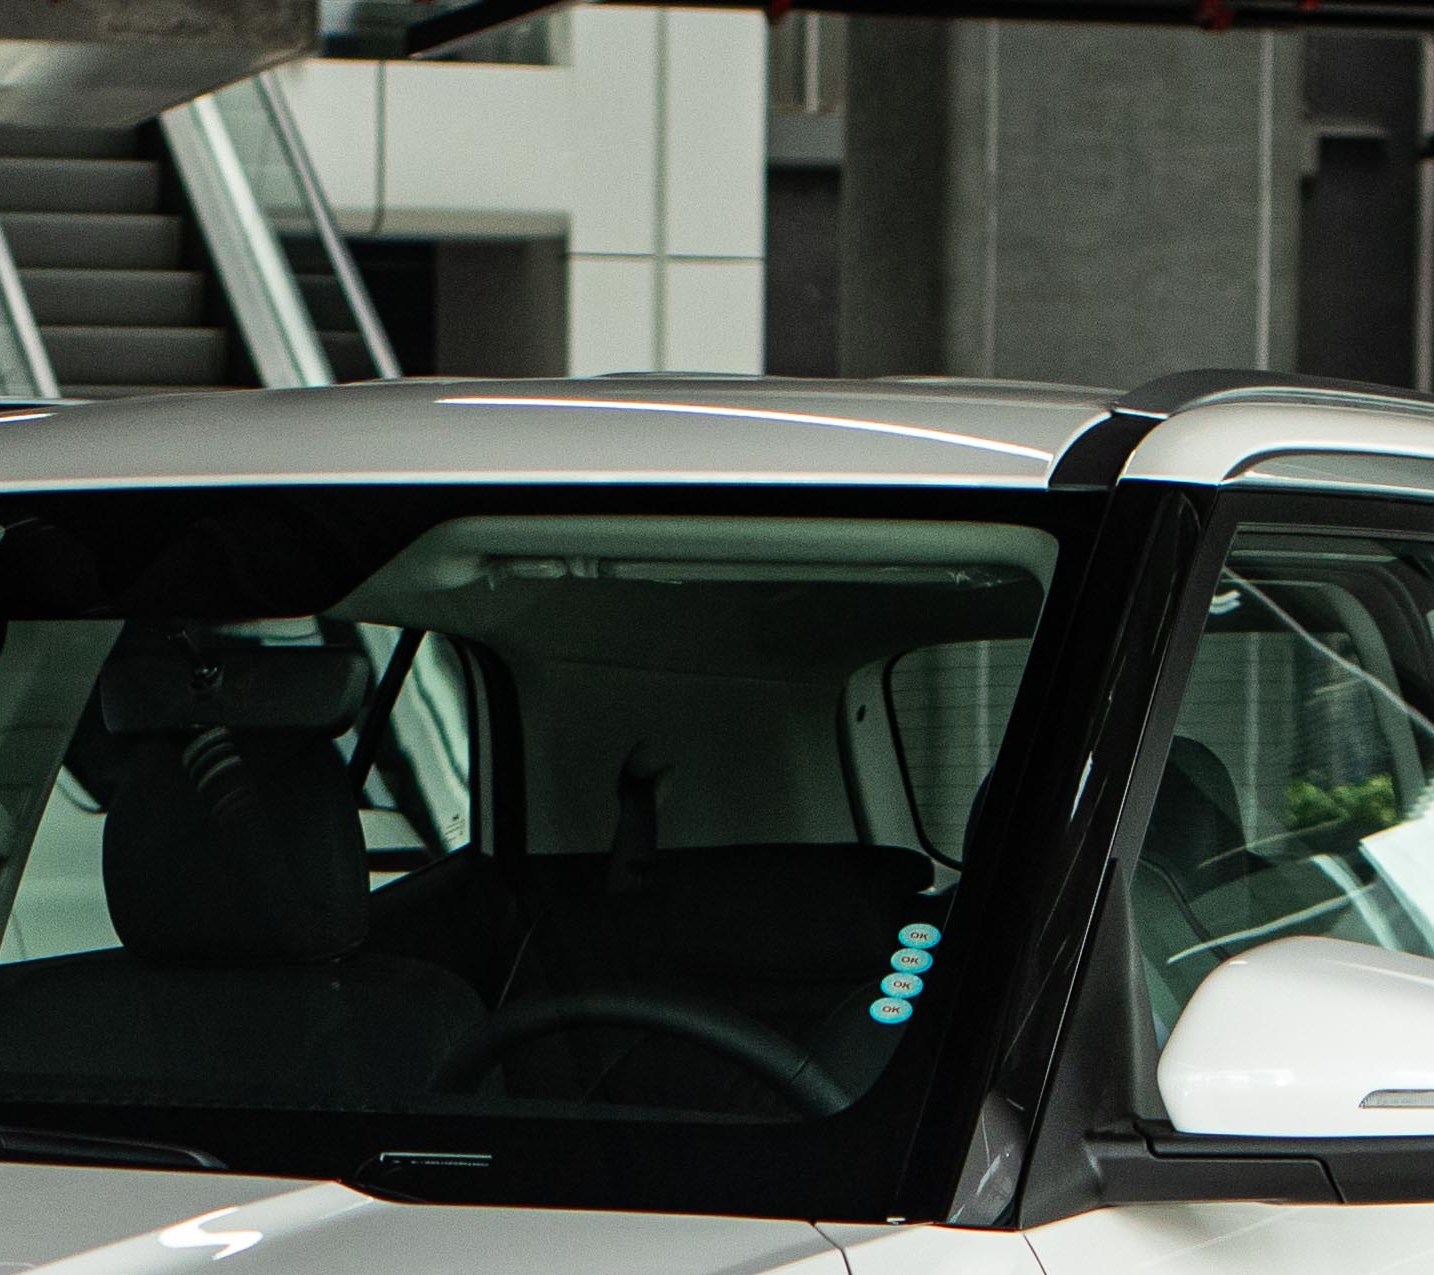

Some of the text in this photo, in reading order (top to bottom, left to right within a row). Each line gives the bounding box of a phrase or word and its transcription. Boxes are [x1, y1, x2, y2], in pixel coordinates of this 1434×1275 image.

[910, 931, 929, 941] OK
[901, 955, 919, 965] OK
[893, 980, 911, 990] OK
[881, 1005, 901, 1014] OK
